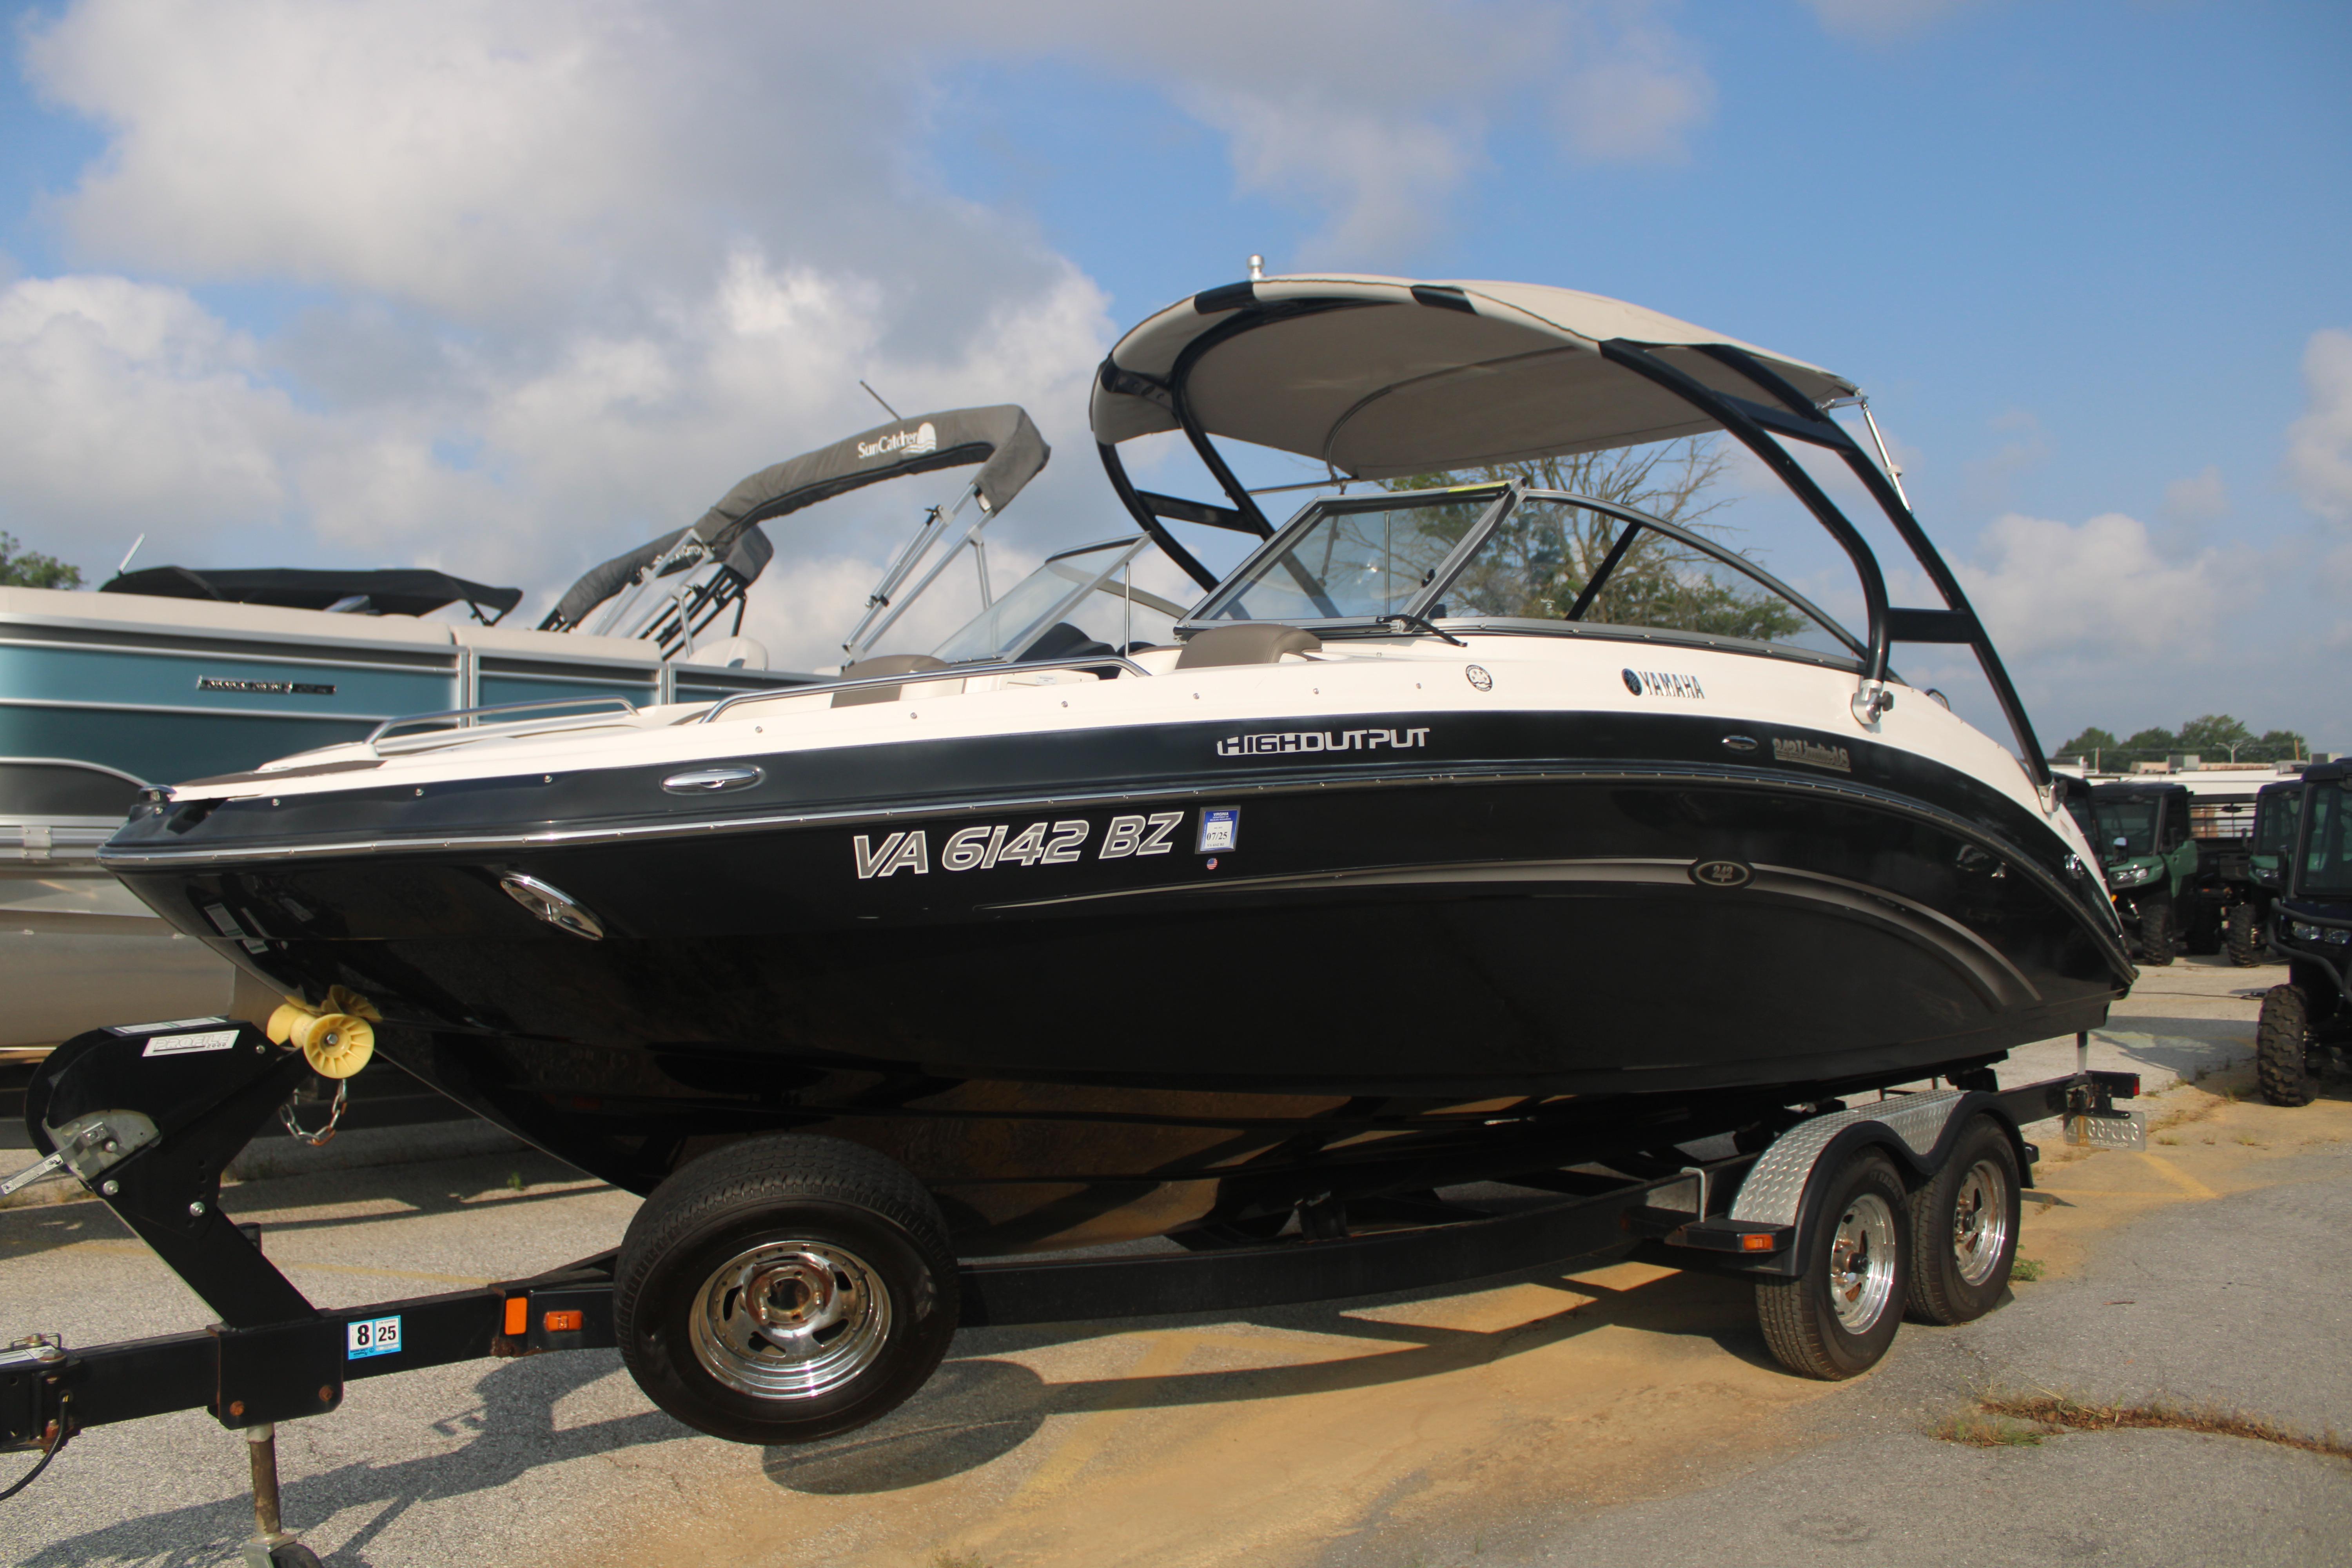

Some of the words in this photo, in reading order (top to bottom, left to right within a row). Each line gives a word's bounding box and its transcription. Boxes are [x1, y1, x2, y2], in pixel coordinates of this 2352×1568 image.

[858, 431, 917, 459] SunCatcher
[1638, 671, 1705, 699] YAMAHA
[854, 830, 928, 878] VA
[942, 820, 1089, 871] 6142
[1099, 811, 1184, 859] BZ
[1207, 831, 1228, 841] 07/25
[1712, 865, 1733, 882] 242
[154, 1034, 231, 1049] PROFILE
[358, 1324, 370, 1346] 8
[378, 1325, 396, 1342] 25
